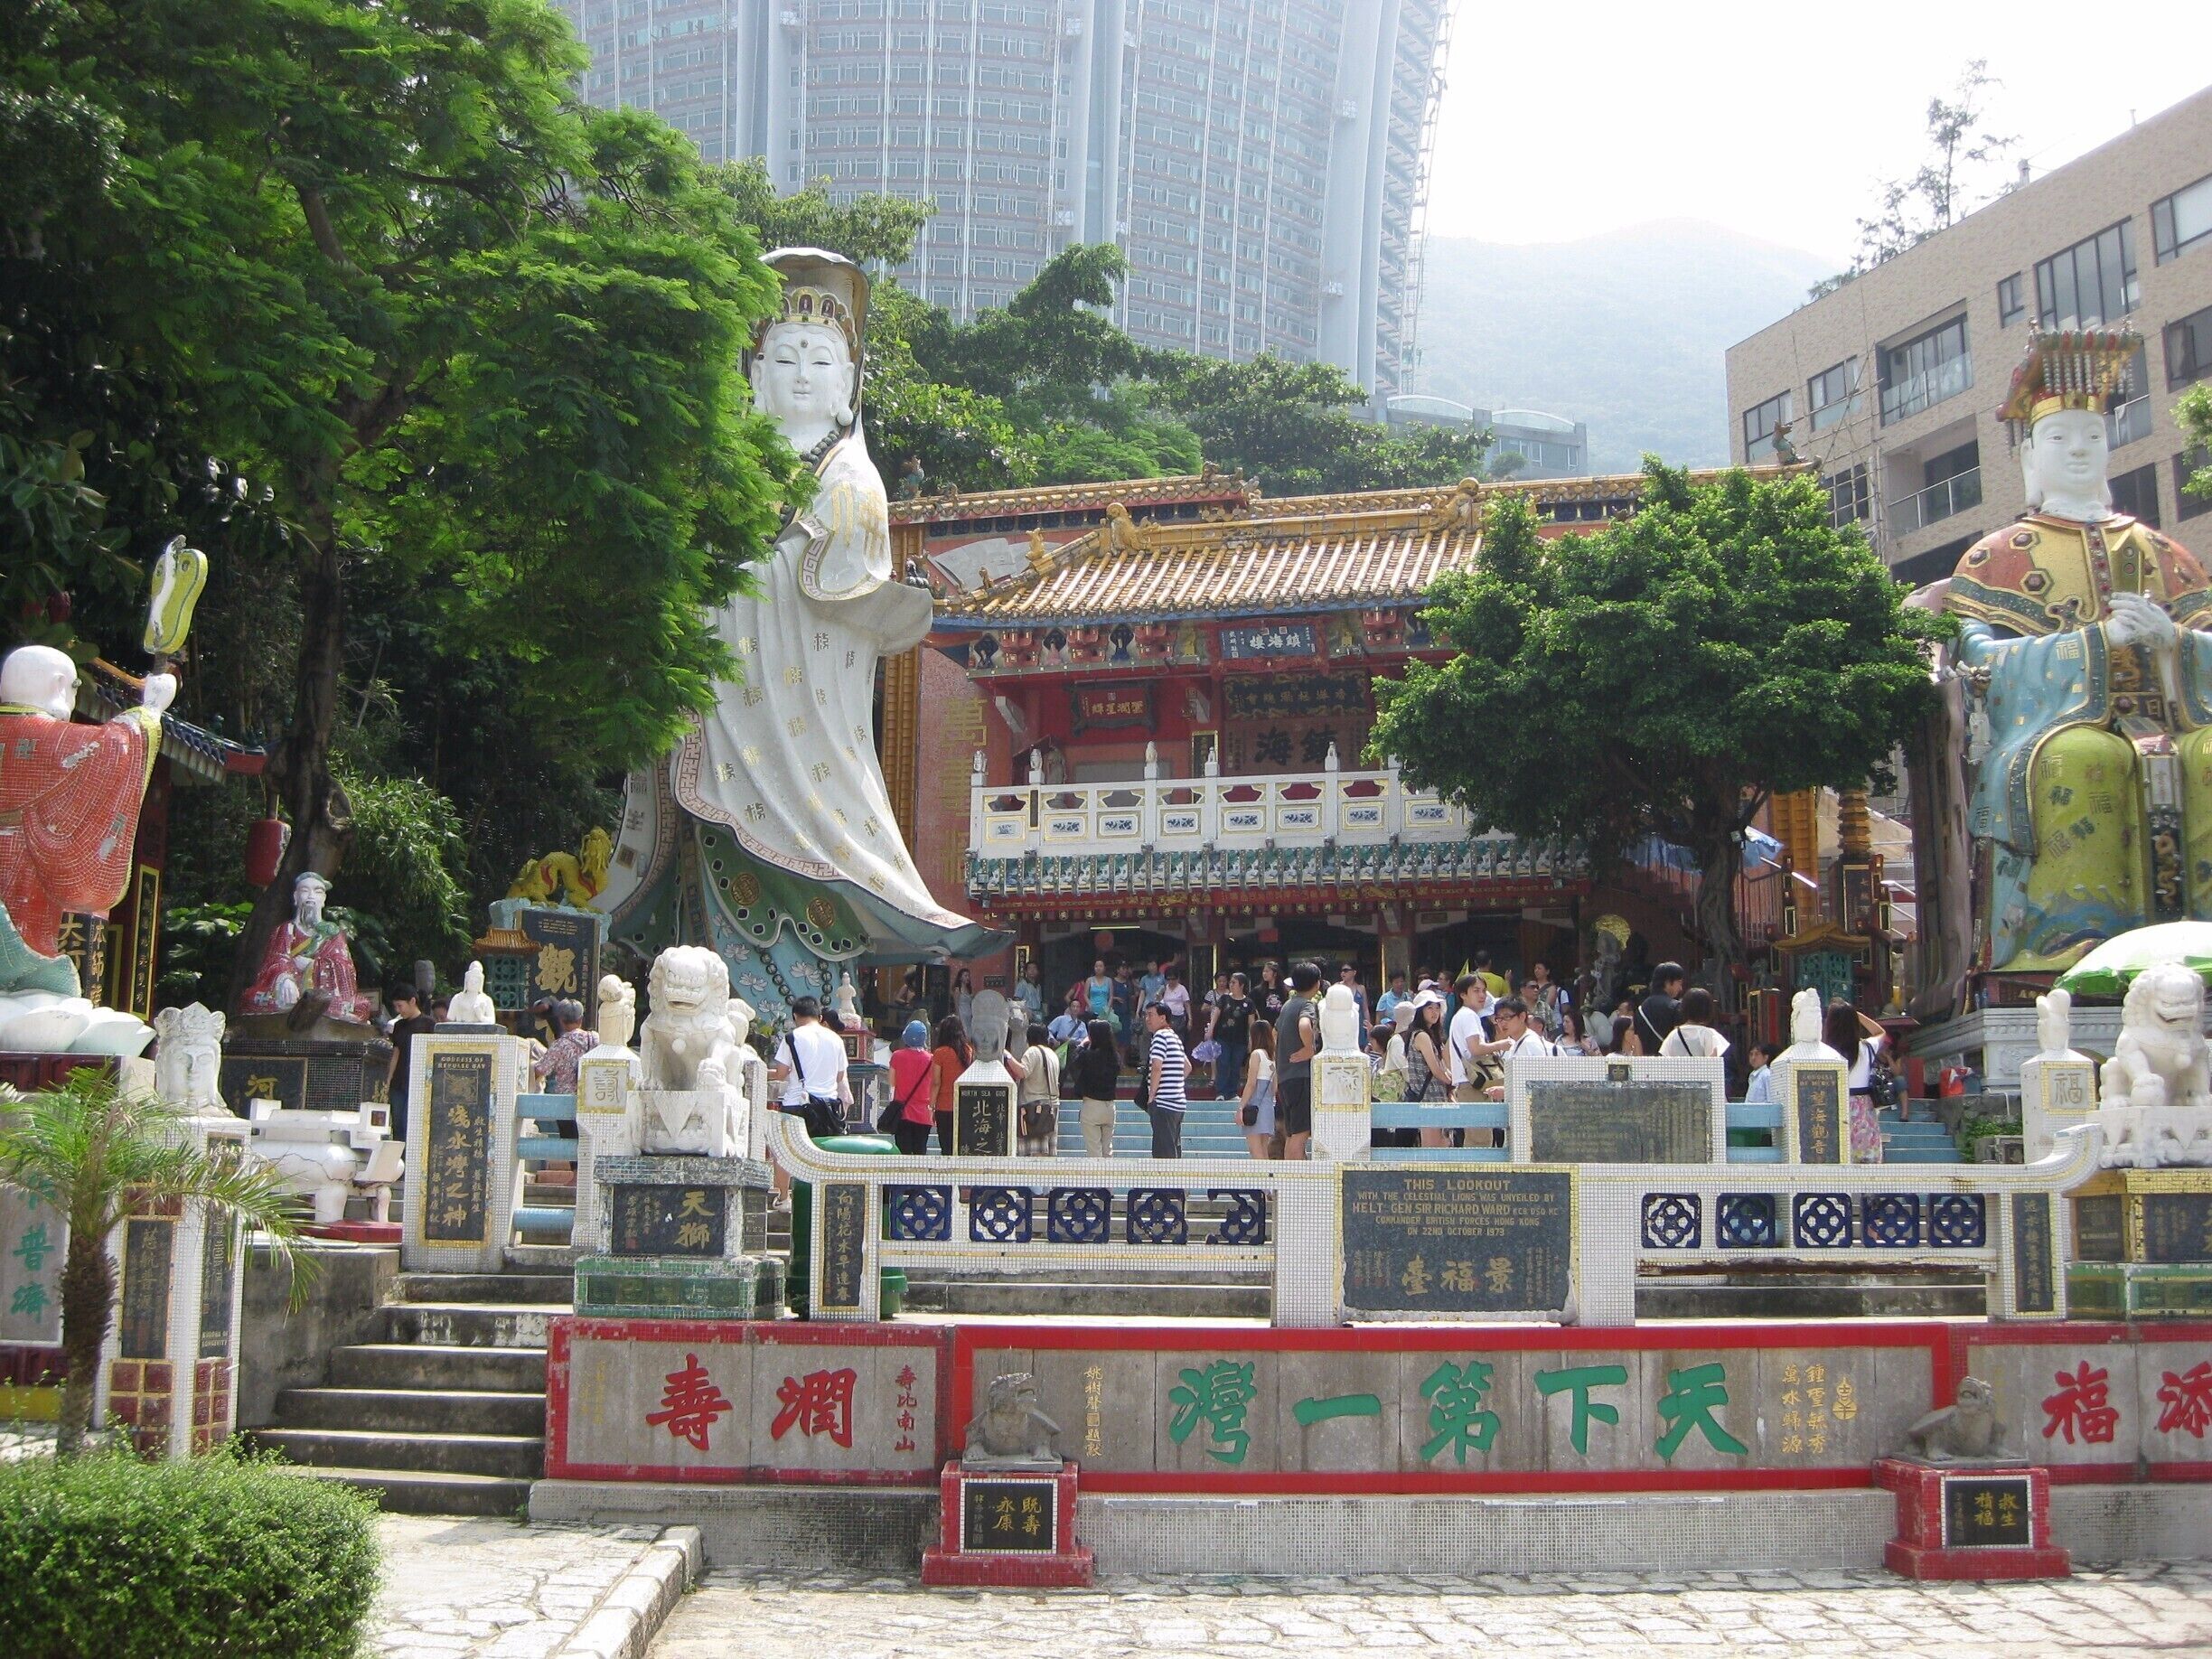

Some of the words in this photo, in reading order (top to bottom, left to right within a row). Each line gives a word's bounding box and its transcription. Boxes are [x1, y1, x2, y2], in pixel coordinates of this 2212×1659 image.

[2053, 1073, 2083, 1104] 福
[972, 1100, 993, 1154] 北海之
[442, 1103, 472, 1229] 淺水灣之神
[1403, 1178, 1435, 1190] THIS
[1447, 1179, 1511, 1191] LOOKOUT
[1358, 1192, 1378, 1200] WITH
[1383, 1192, 1399, 1201] THE
[1403, 1192, 1447, 1201] CELESTIAL
[1452, 1193, 1476, 1202] LIONS
[1479, 1193, 1496, 1202] WAS
[1501, 1193, 1540, 1203] UNVEILED
[1544, 1193, 1555, 1203] BY
[1434, 1204, 1479, 1215] RICHARD
[1482, 1204, 1510, 1215] WARD
[673, 1190, 716, 1251] 天獅
[1375, 1216, 1420, 1224] COMMANDER
[1426, 1216, 1456, 1224] BRITISH
[1459, 1216, 1490, 1225] FORCES
[1495, 1217, 1515, 1225] HONG
[1519, 1217, 1540, 1226] KONG
[1407, 1227, 1418, 1235] ON
[1422, 1227, 1443, 1235] 22ND
[1448, 1227, 1483, 1236] OCTOBER
[1486, 1227, 1505, 1236] 1973
[1401, 1252, 1514, 1296] 景福臺
[895, 1364, 918, 1453] 壽比南山
[1168, 1359, 1748, 1465] 天下第一灣
[991, 1495, 1017, 1532] 永康
